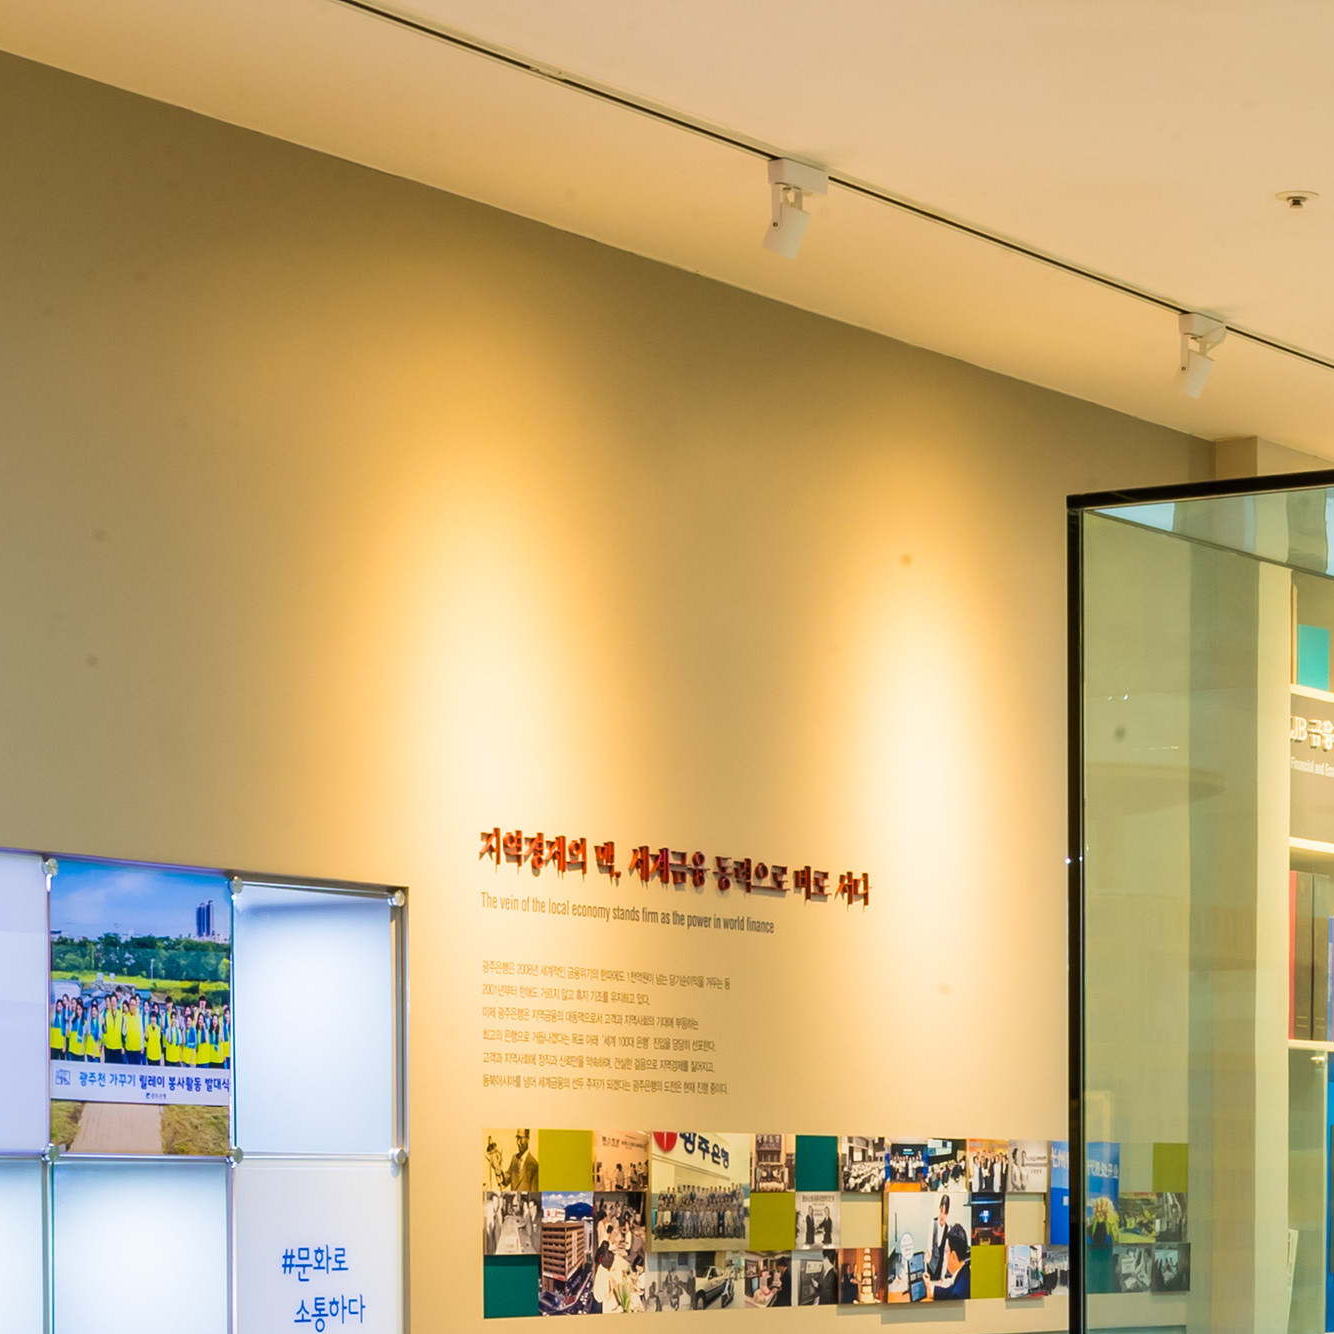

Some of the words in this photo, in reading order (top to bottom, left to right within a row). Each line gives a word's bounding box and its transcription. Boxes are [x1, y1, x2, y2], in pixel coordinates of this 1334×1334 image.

[479, 827, 586, 877] 지역경제의
[481, 891, 498, 908] The
[500, 896, 519, 911] vein
[521, 896, 530, 911] of
[532, 898, 546, 913] the
[548, 899, 569, 916] local
[571, 903, 610, 922] economy
[612, 905, 640, 922] stands
[642, 907, 658, 923] firm
[660, 912, 670, 925] as
[672, 910, 685, 926] the
[687, 912, 712, 930] power
[714, 914, 721, 928] in
[723, 915, 744, 930] world
[746, 916, 774, 933] finance
[79, 1071, 105, 1088] 광주천
[109, 1073, 136, 1088] 가꾸기
[139, 1074, 165, 1090] 릴레이
[168, 1076, 202, 1092] 봉사활동
[281, 1245, 349, 1283] #문화로
[294, 1294, 366, 1333] 소통하다
